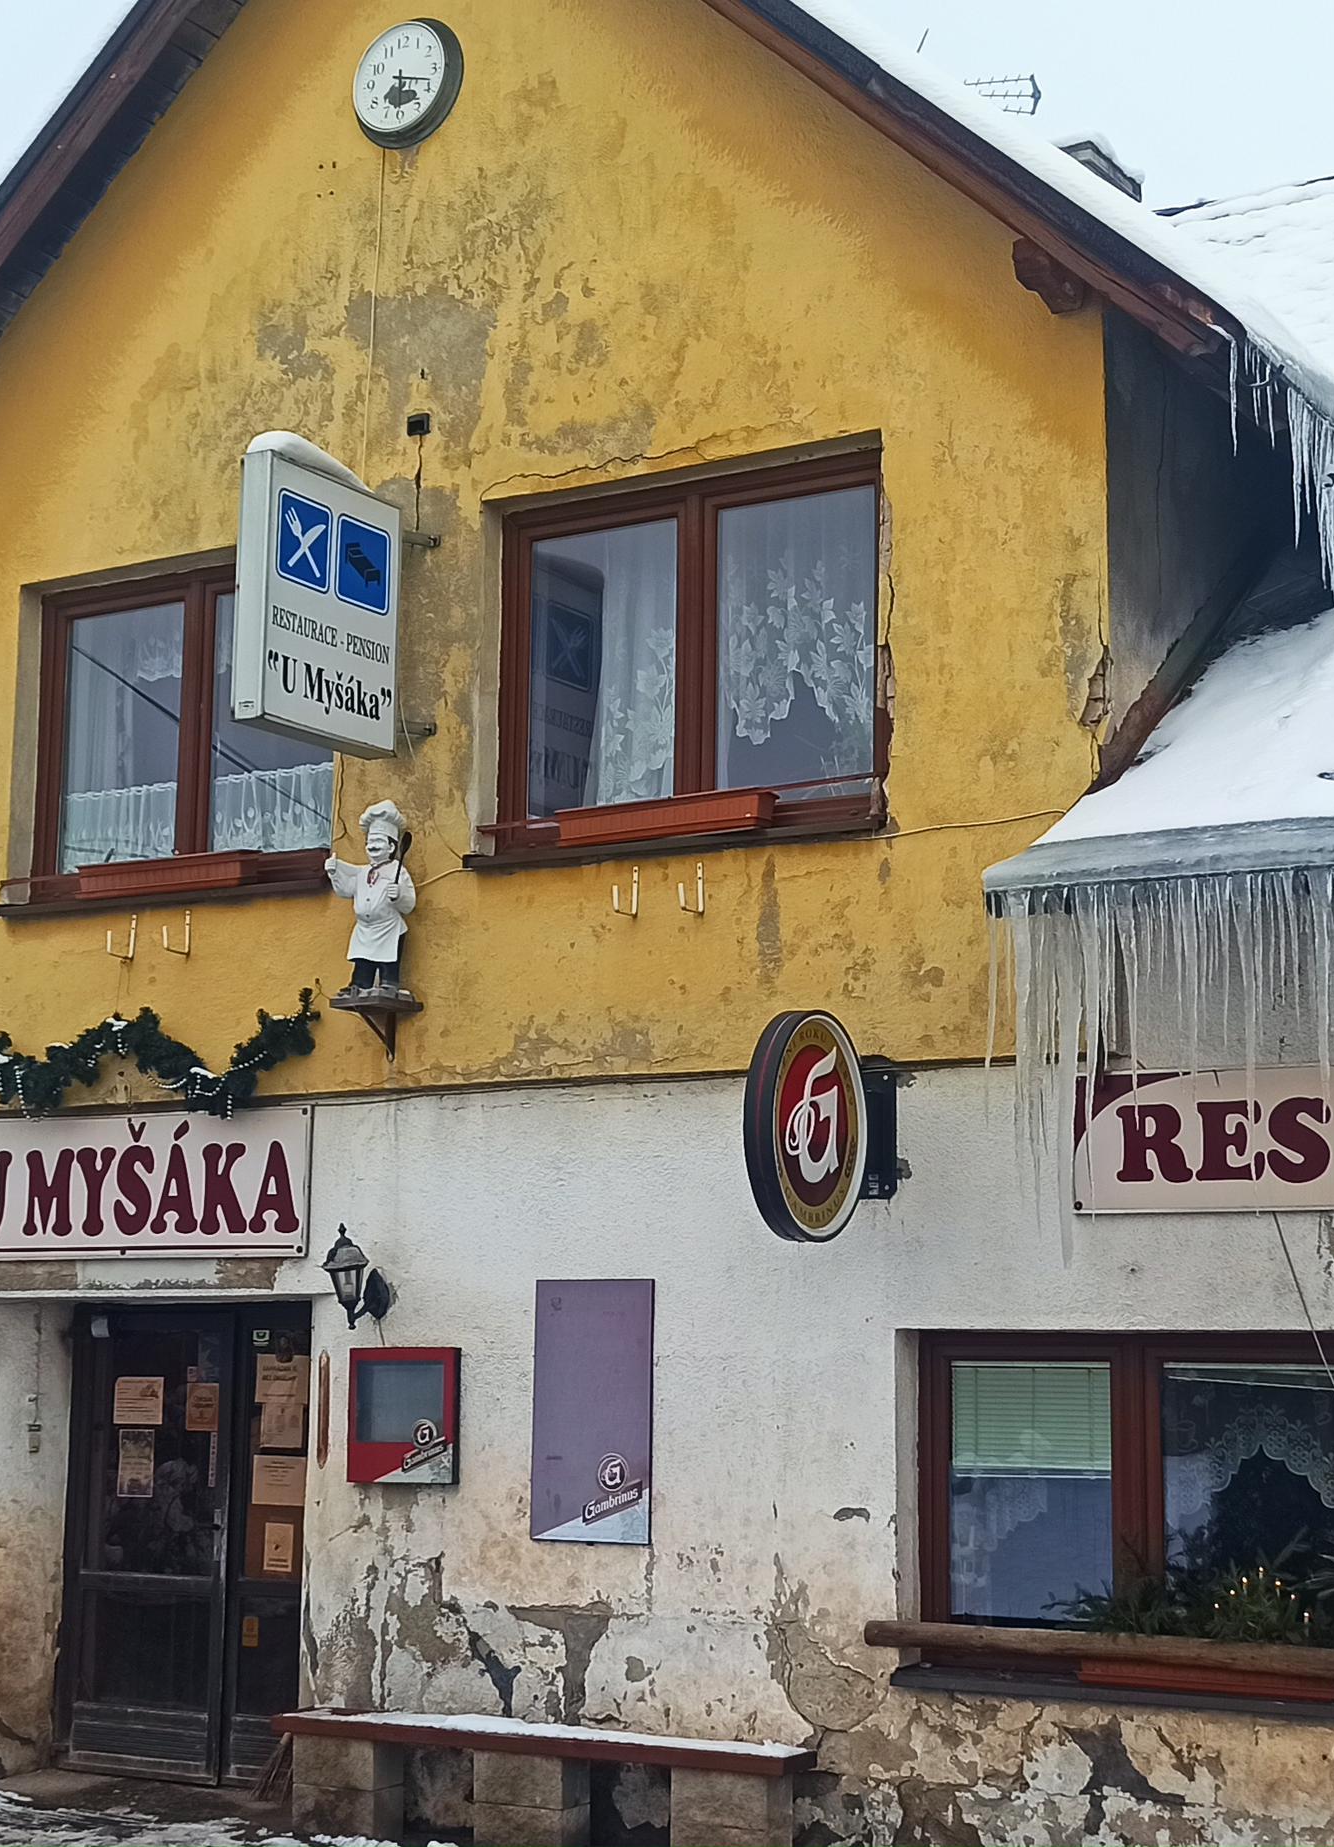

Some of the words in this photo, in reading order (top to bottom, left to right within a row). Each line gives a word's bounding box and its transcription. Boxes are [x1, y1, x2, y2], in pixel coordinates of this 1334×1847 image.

[272, 605, 338, 648] RESTAURACE
[346, 632, 390, 664] PENSION
[22, 1119, 300, 1237] MYŠÁKA
[784, 1187, 845, 1223] GAMBRINUS
[417, 1424, 430, 1443] G
[602, 1459, 622, 1486] G
[584, 1487, 639, 1519] Gambrinus
